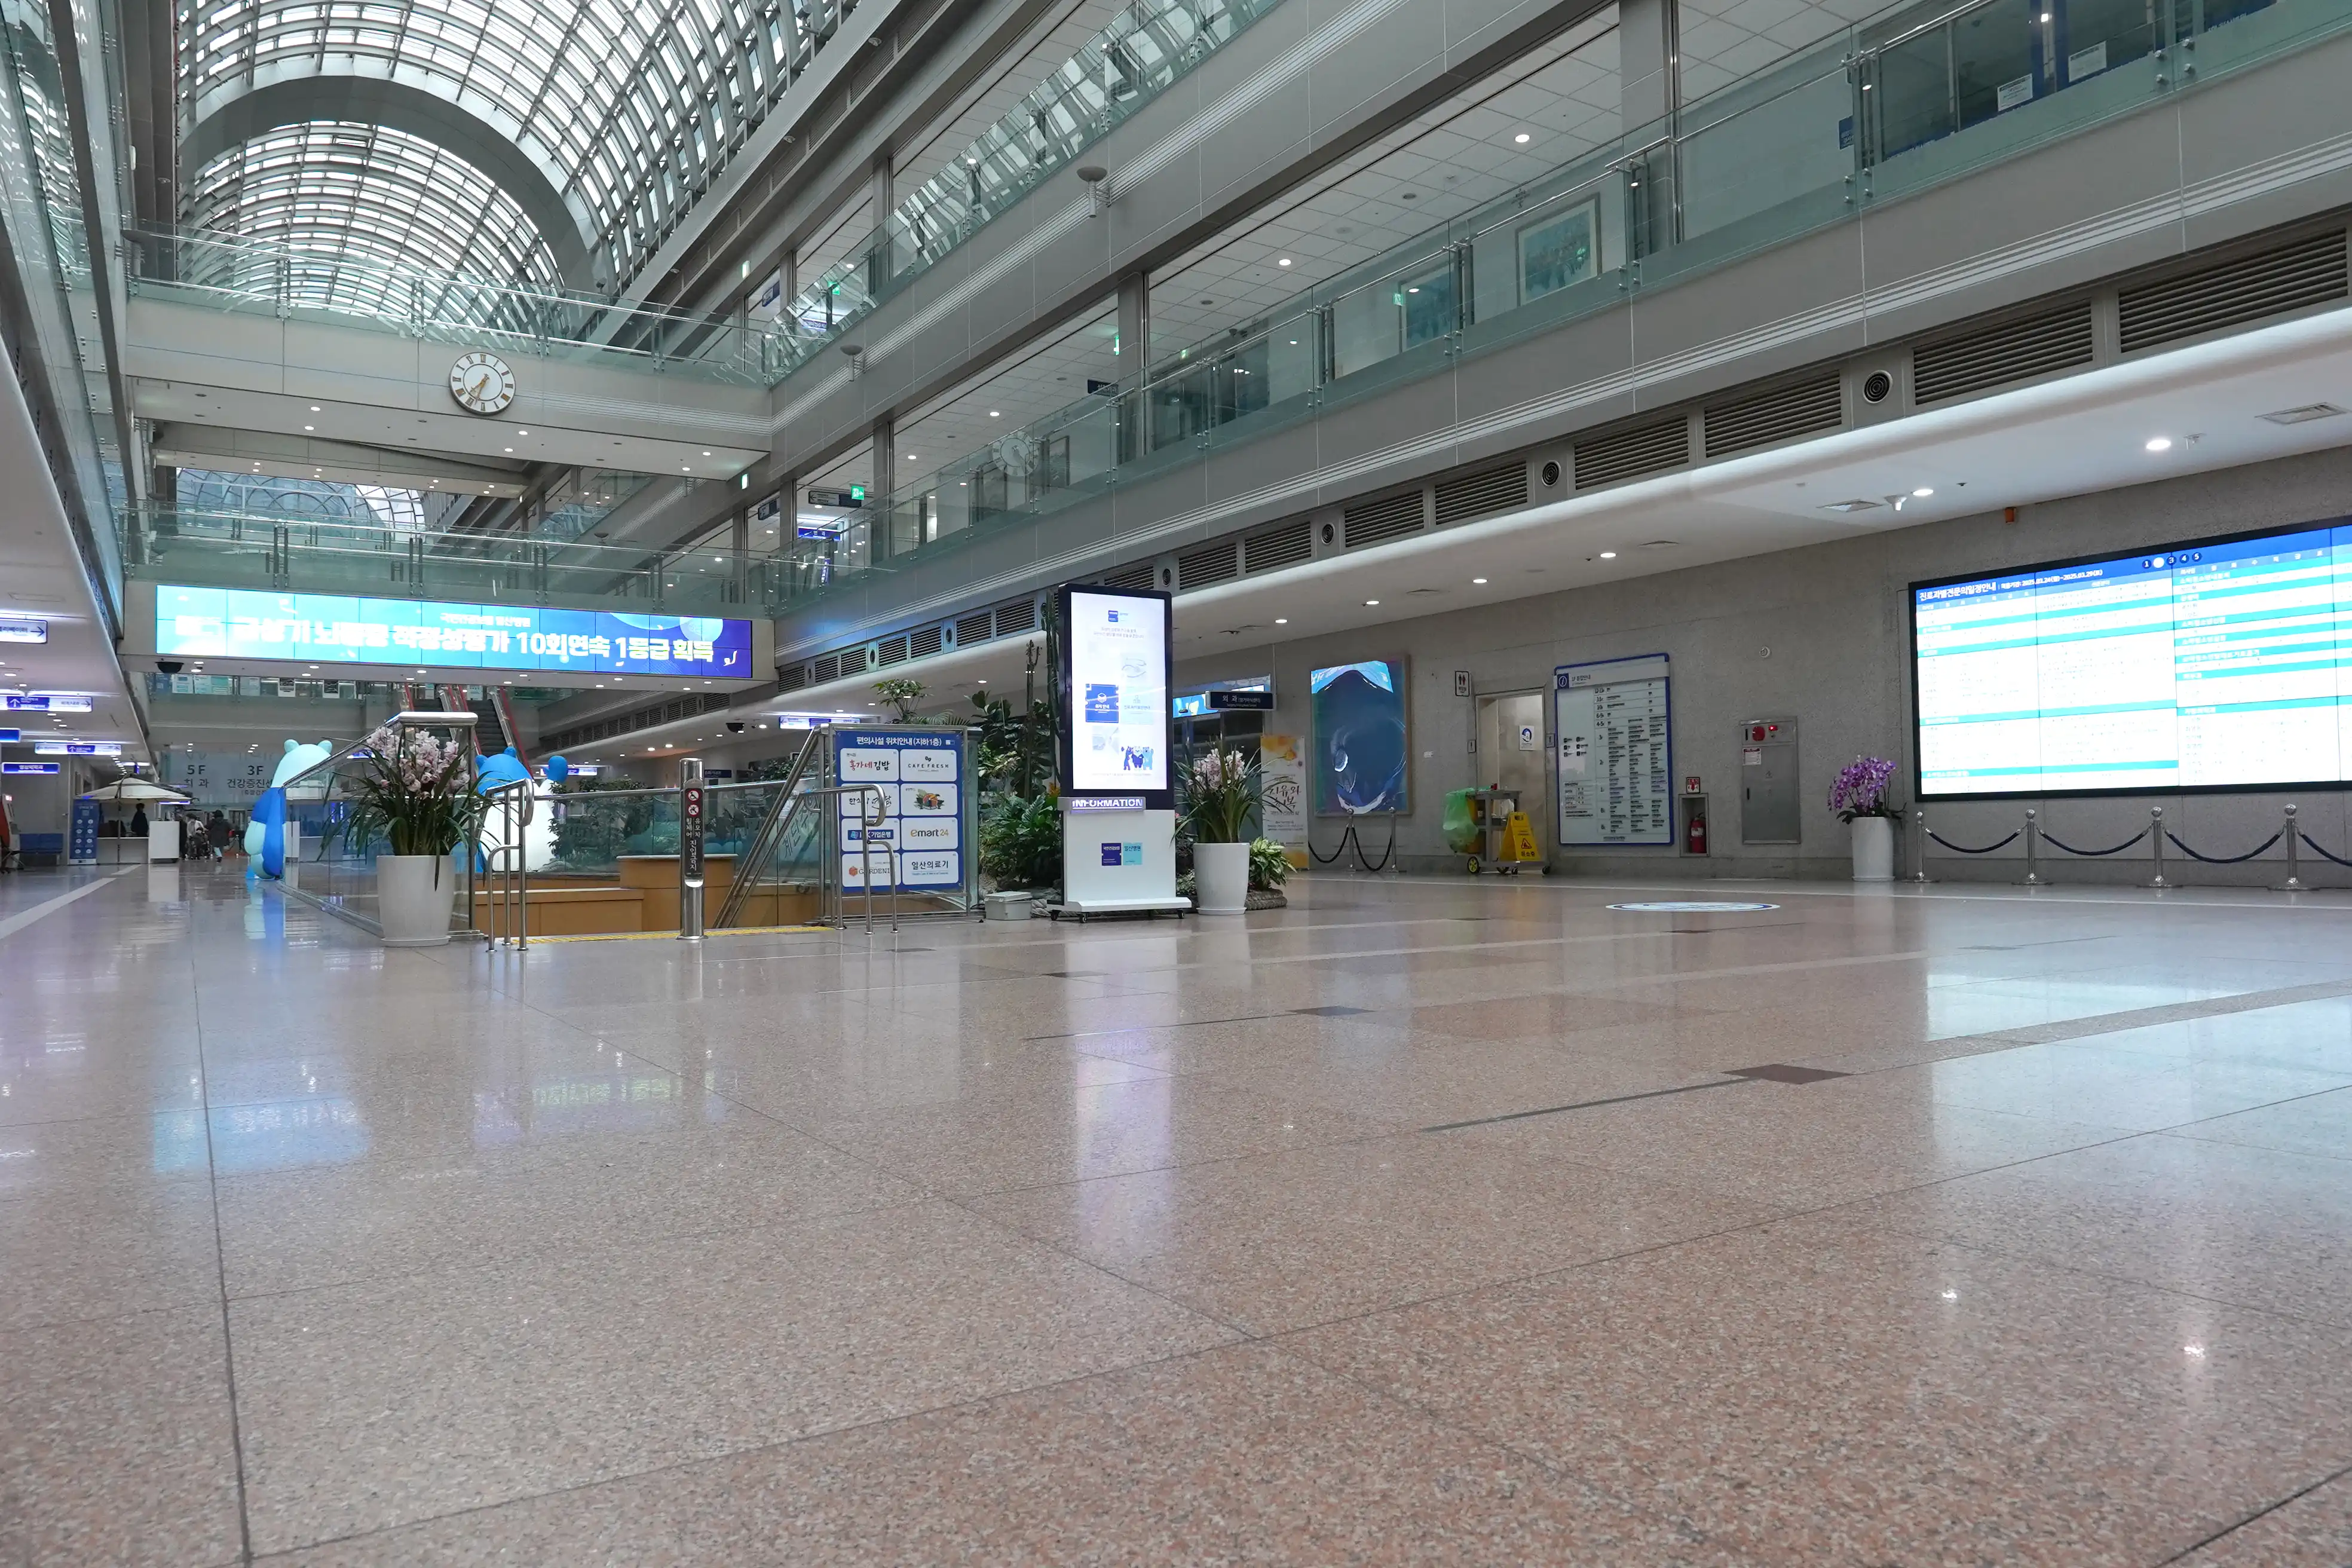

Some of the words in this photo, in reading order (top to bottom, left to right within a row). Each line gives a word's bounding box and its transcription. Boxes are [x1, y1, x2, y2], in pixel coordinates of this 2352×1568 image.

[517, 632, 610, 658] 10회연속
[615, 637, 670, 660] 1등급
[673, 639, 713, 662] 획득
[856, 737, 884, 745] 편의시설
[247, 765, 264, 776] 3F
[850, 760, 890, 771] 홍가네김밥
[227, 778, 272, 789] 건강증진센
[1072, 798, 1143, 807] INFORMATION
[910, 829, 949, 837] emart24
[690, 840, 698, 871] 진입금지
[911, 860, 949, 870] 일산의료기
